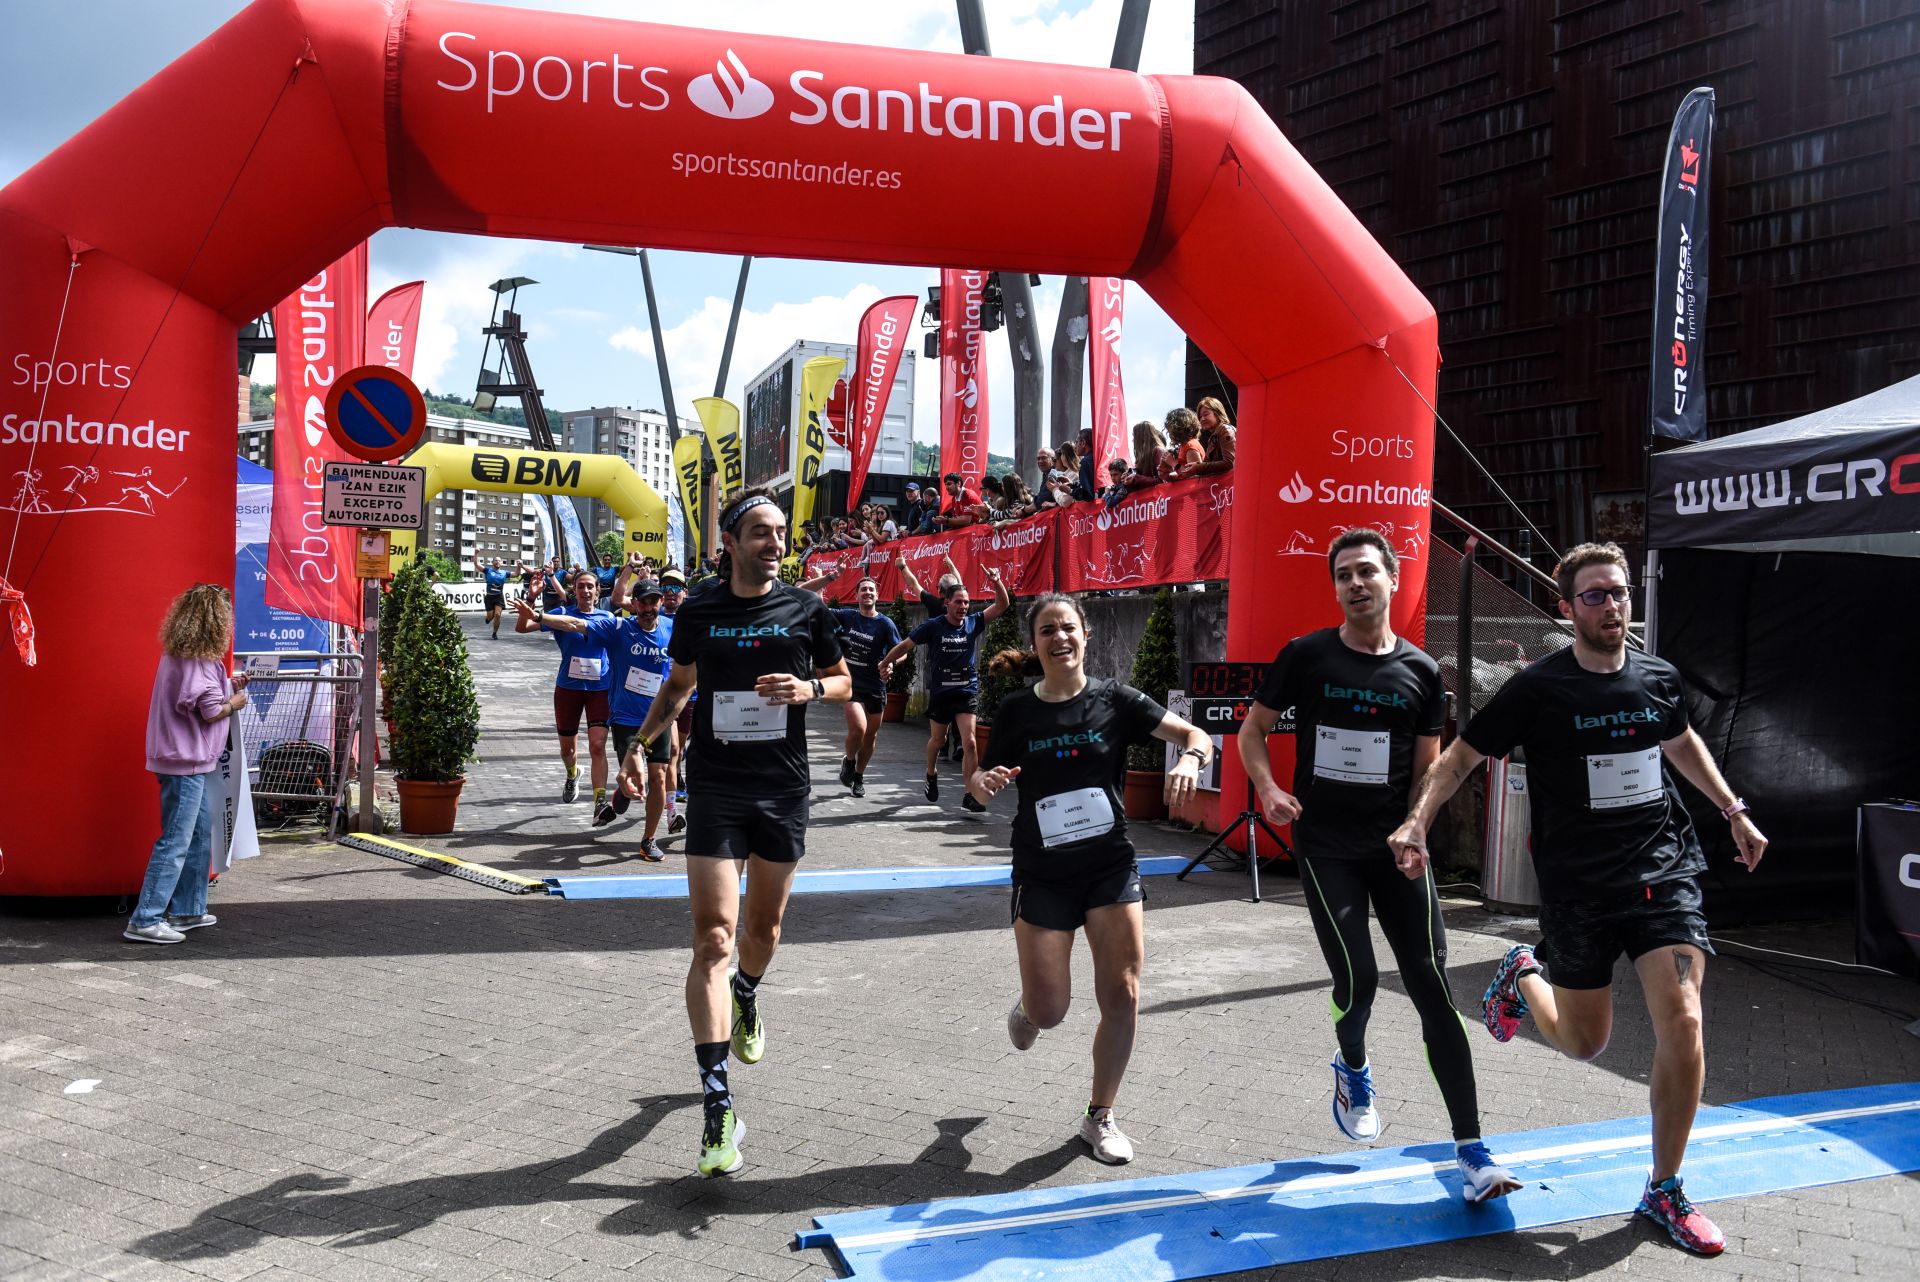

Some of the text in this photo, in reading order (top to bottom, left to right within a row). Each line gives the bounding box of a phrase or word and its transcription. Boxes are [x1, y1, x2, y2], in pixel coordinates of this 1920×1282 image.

[436, 31, 1131, 152] Sports Santander
[671, 150, 902, 189] sportssantander.es
[961, 269, 982, 375] Santand
[1686, 294, 1696, 341] Timing
[12, 353, 132, 394] Sports
[1, 413, 190, 452] Santander
[1330, 429, 1414, 463] Sports
[332, 467, 417, 482] BAIMENDUAK
[514, 456, 581, 488] BM
[341, 481, 407, 494] IZAN EZIK
[1318, 478, 1431, 508] Santander
[235, 503, 272, 514] esari
[343, 498, 403, 510] EXCEPTO
[1113, 496, 1171, 528] Santander
[328, 510, 418, 524] AUTORIZADOS
[644, 532, 664, 542] BM
[269, 628, 305, 640] 6.000
[710, 624, 791, 638] lantek
[1323, 683, 1408, 710] lantek
[1573, 707, 1662, 730] lantek
[1028, 729, 1104, 753] lantek
[1341, 745, 1362, 753] LANTEK
[1620, 768, 1640, 776] LANTEK
[1623, 783, 1639, 791] DIEGO
[1064, 805, 1083, 813] LANTEK
[1063, 817, 1091, 828] ELIZABETH
